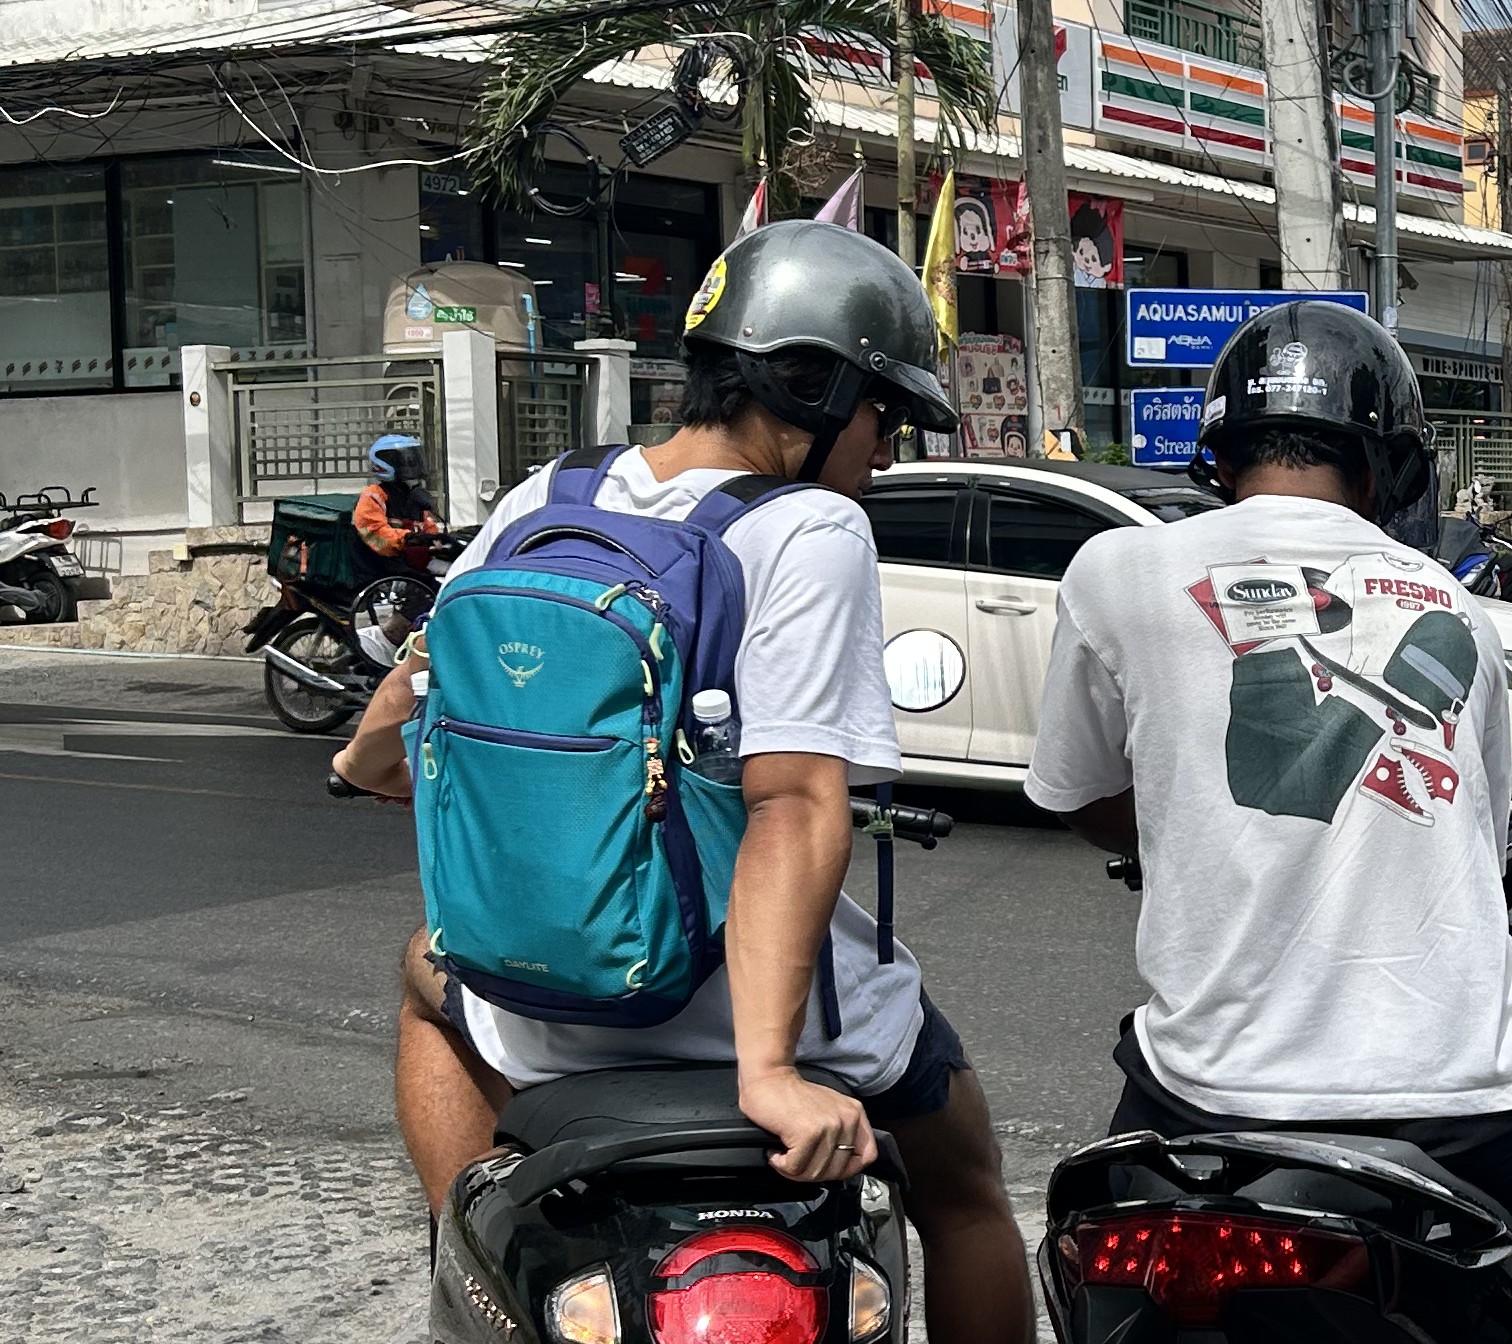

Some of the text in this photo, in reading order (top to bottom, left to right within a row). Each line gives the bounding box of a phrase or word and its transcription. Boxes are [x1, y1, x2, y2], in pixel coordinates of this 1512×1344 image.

[423, 174, 460, 192] 4972
[1136, 303, 1243, 322] AQUASAMUI
[1422, 357, 1447, 375] WINE
[1232, 583, 1294, 600] Sunday
[1364, 578, 1453, 610] FRESNO
[498, 641, 546, 659] OSPREY
[503, 959, 550, 973] DAYLITE
[698, 1209, 775, 1221] HONDA
